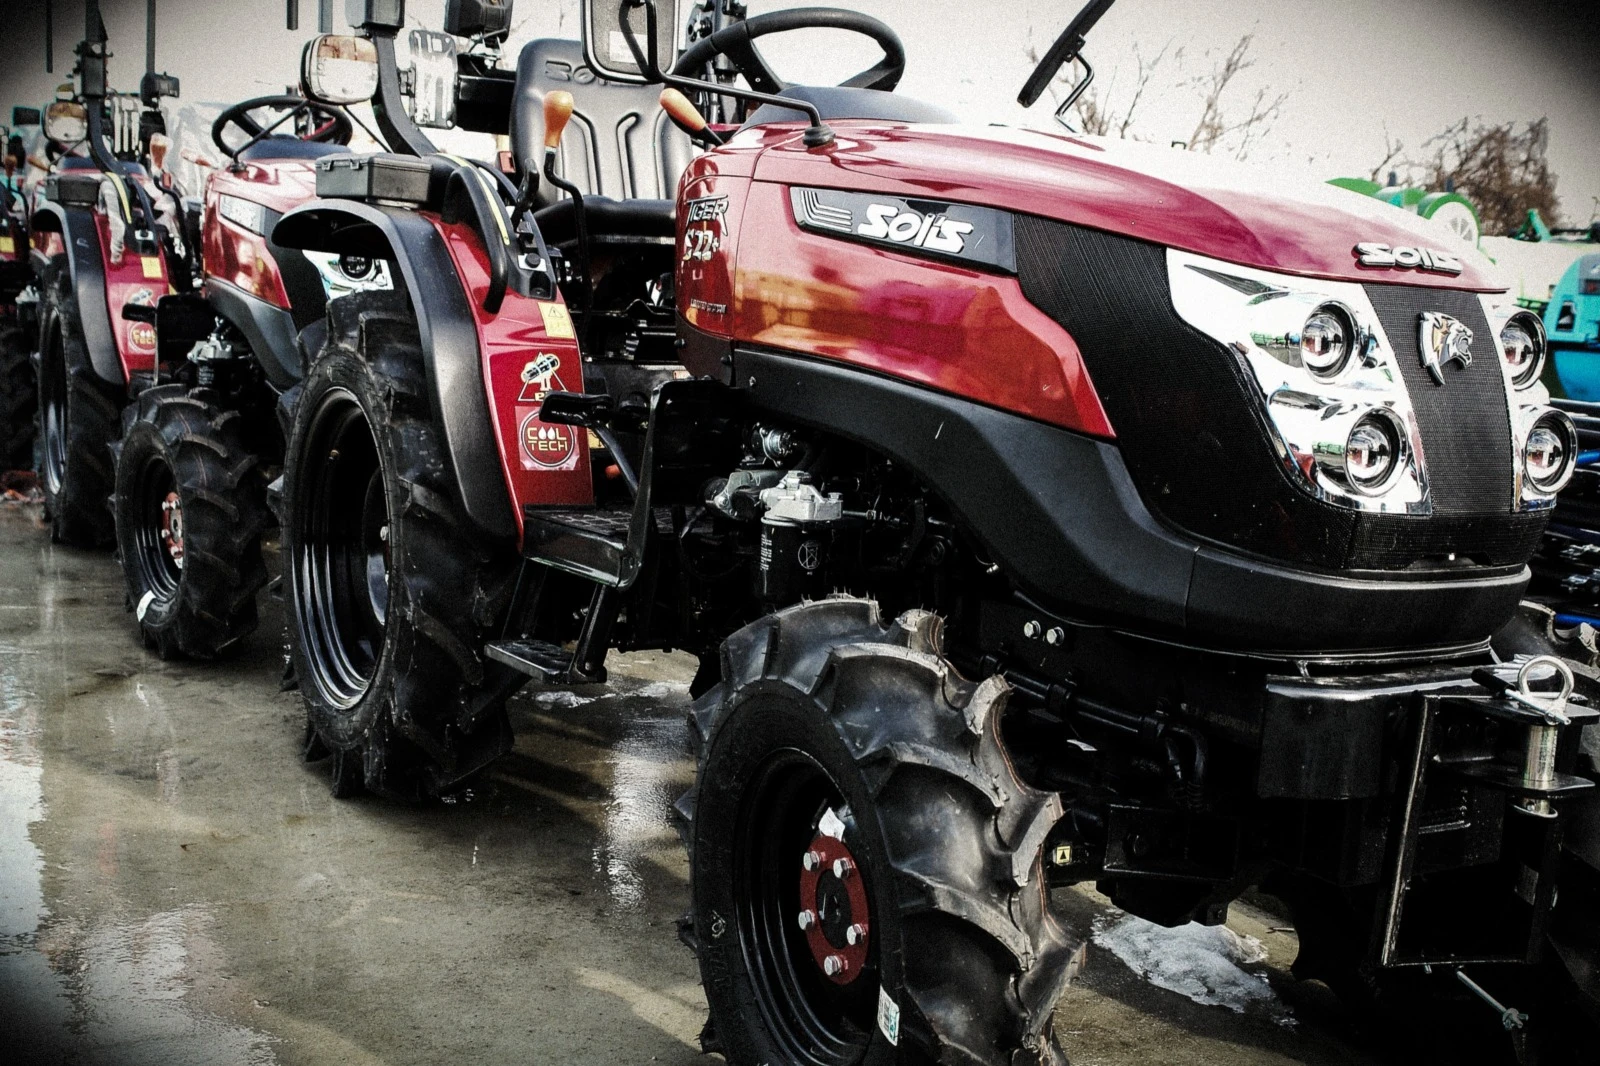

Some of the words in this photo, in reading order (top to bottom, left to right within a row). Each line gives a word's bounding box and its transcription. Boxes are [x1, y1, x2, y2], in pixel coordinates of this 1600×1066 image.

[686, 195, 729, 236] TIGER
[527, 426, 567, 441] COOL
[527, 440, 568, 451] TECH
